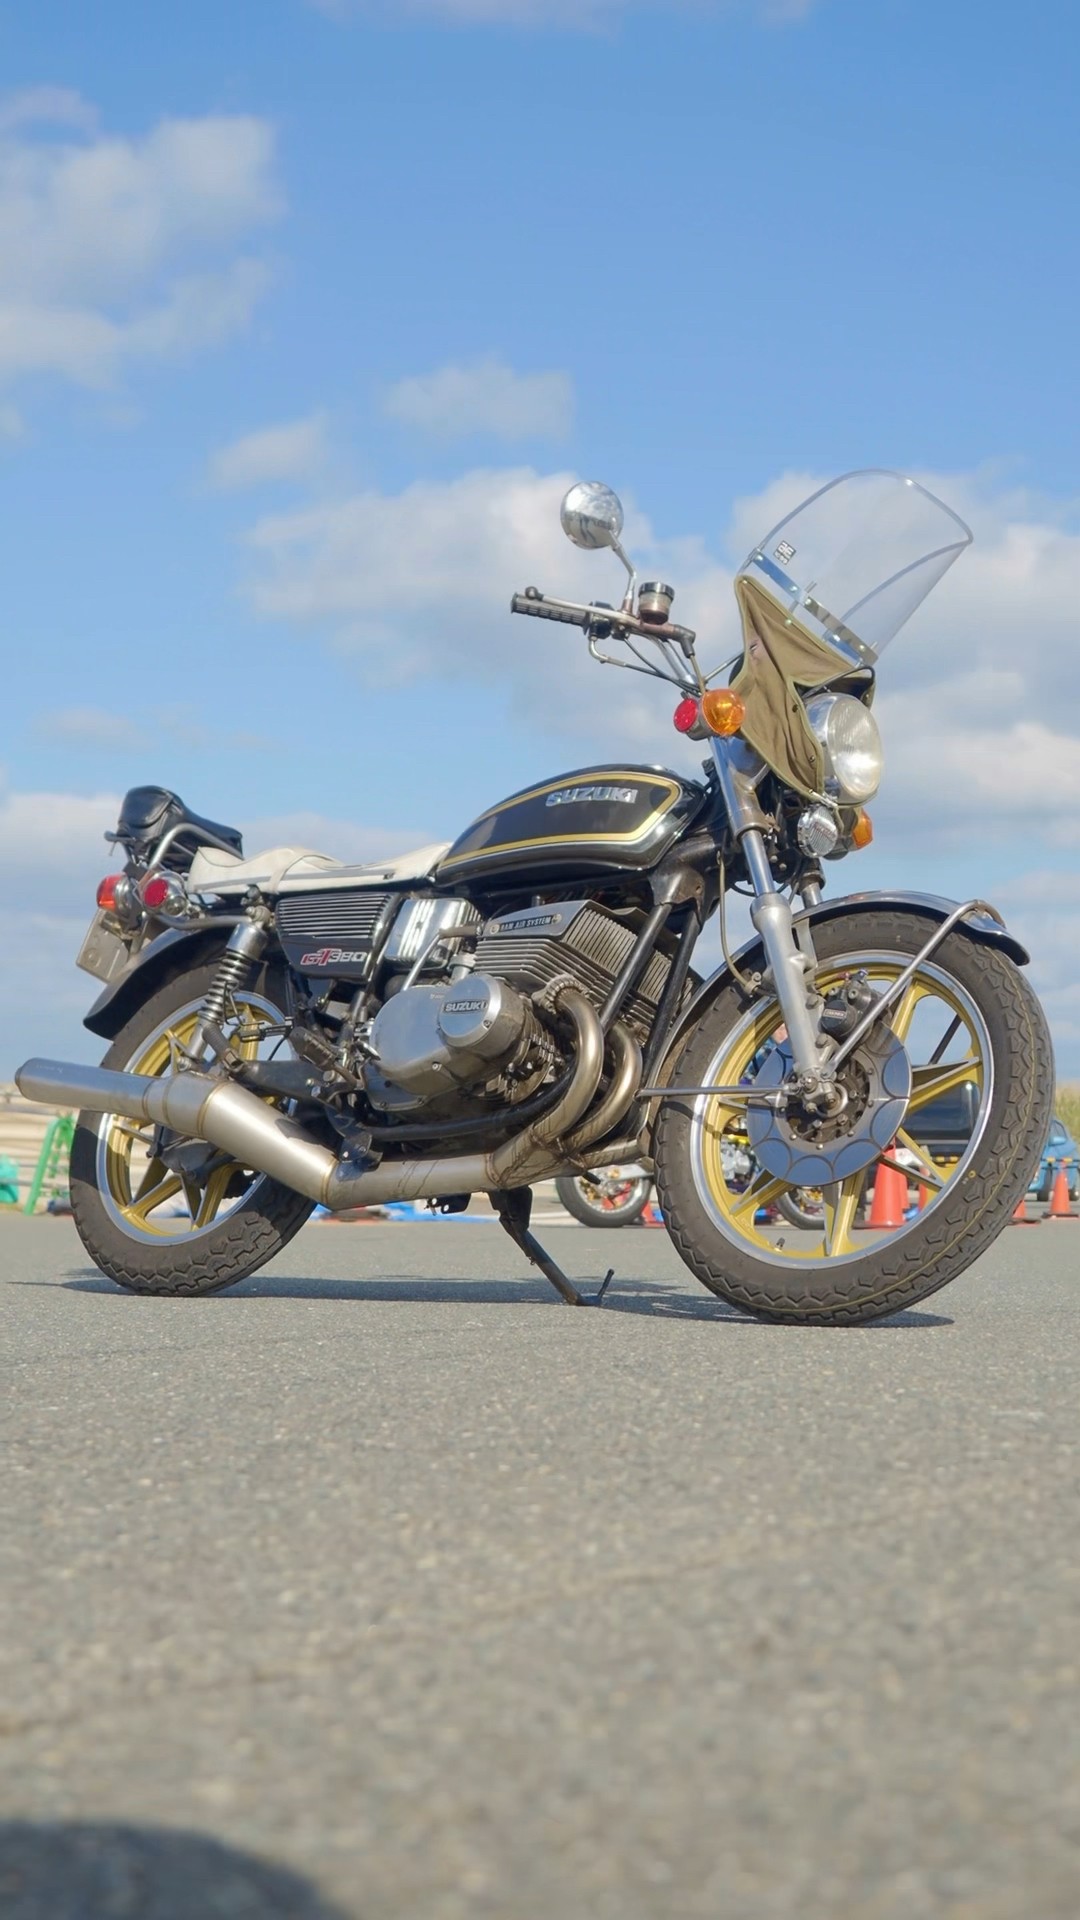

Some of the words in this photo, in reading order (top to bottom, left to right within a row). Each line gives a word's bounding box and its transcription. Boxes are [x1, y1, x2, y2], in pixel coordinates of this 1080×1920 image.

[545, 786, 638, 807] SUZUKI
[514, 920, 526, 929] AIR
[526, 916, 552, 927] SYSTEM
[445, 1001, 484, 1012] SUZUKI
